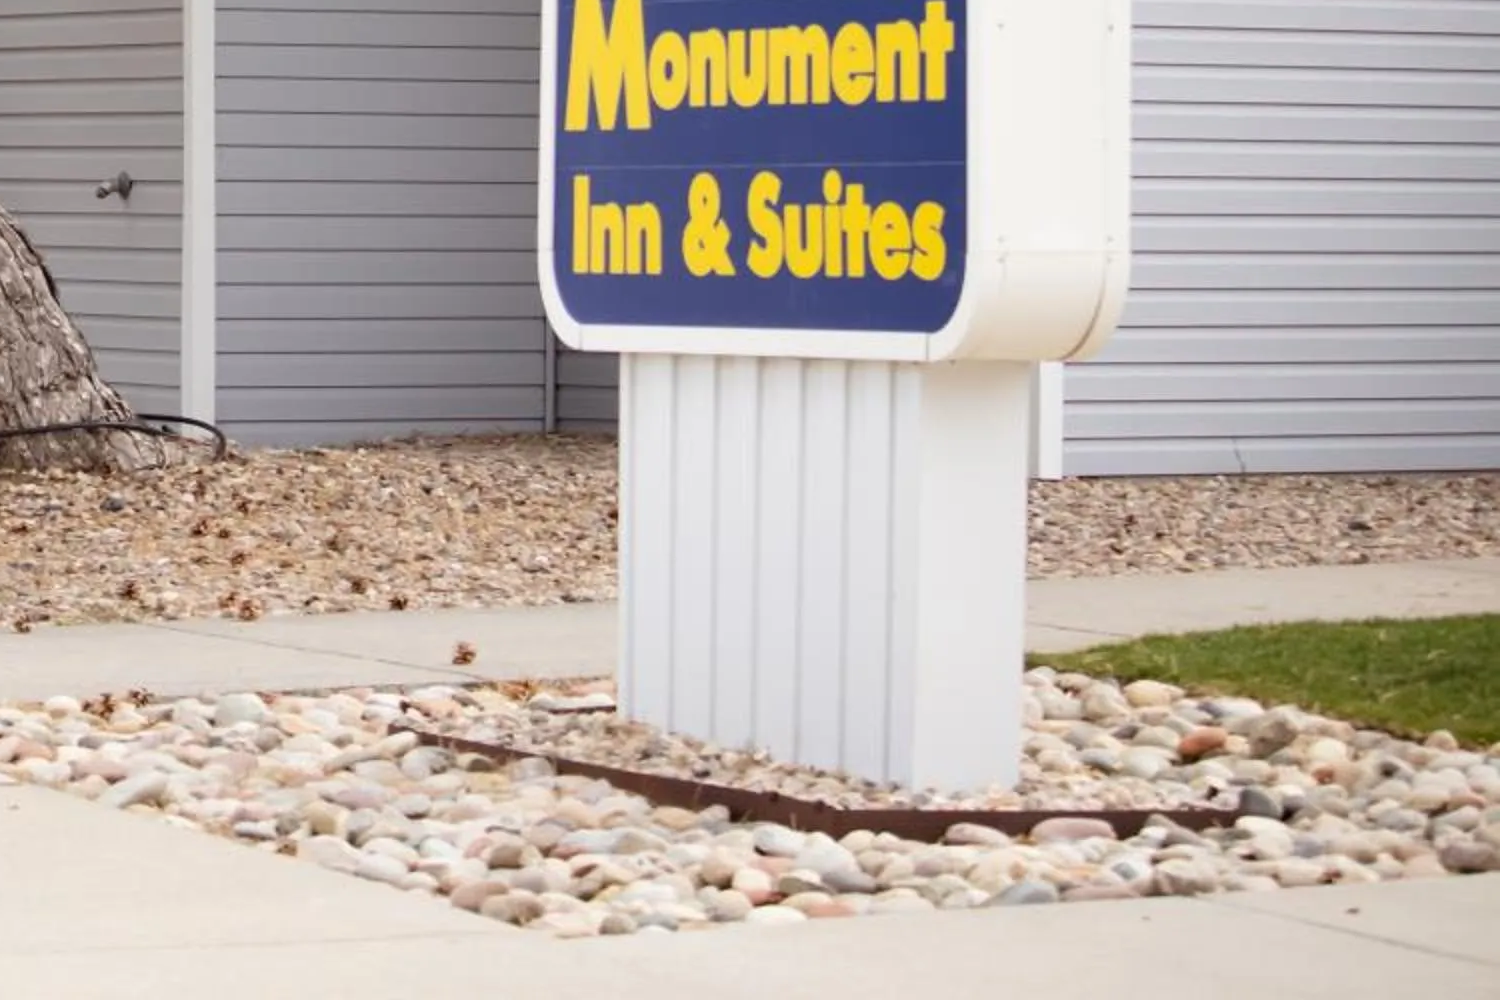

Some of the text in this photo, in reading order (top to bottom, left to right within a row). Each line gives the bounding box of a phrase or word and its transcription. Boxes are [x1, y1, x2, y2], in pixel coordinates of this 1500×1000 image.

[573, 169, 947, 281] Inn & Suites
